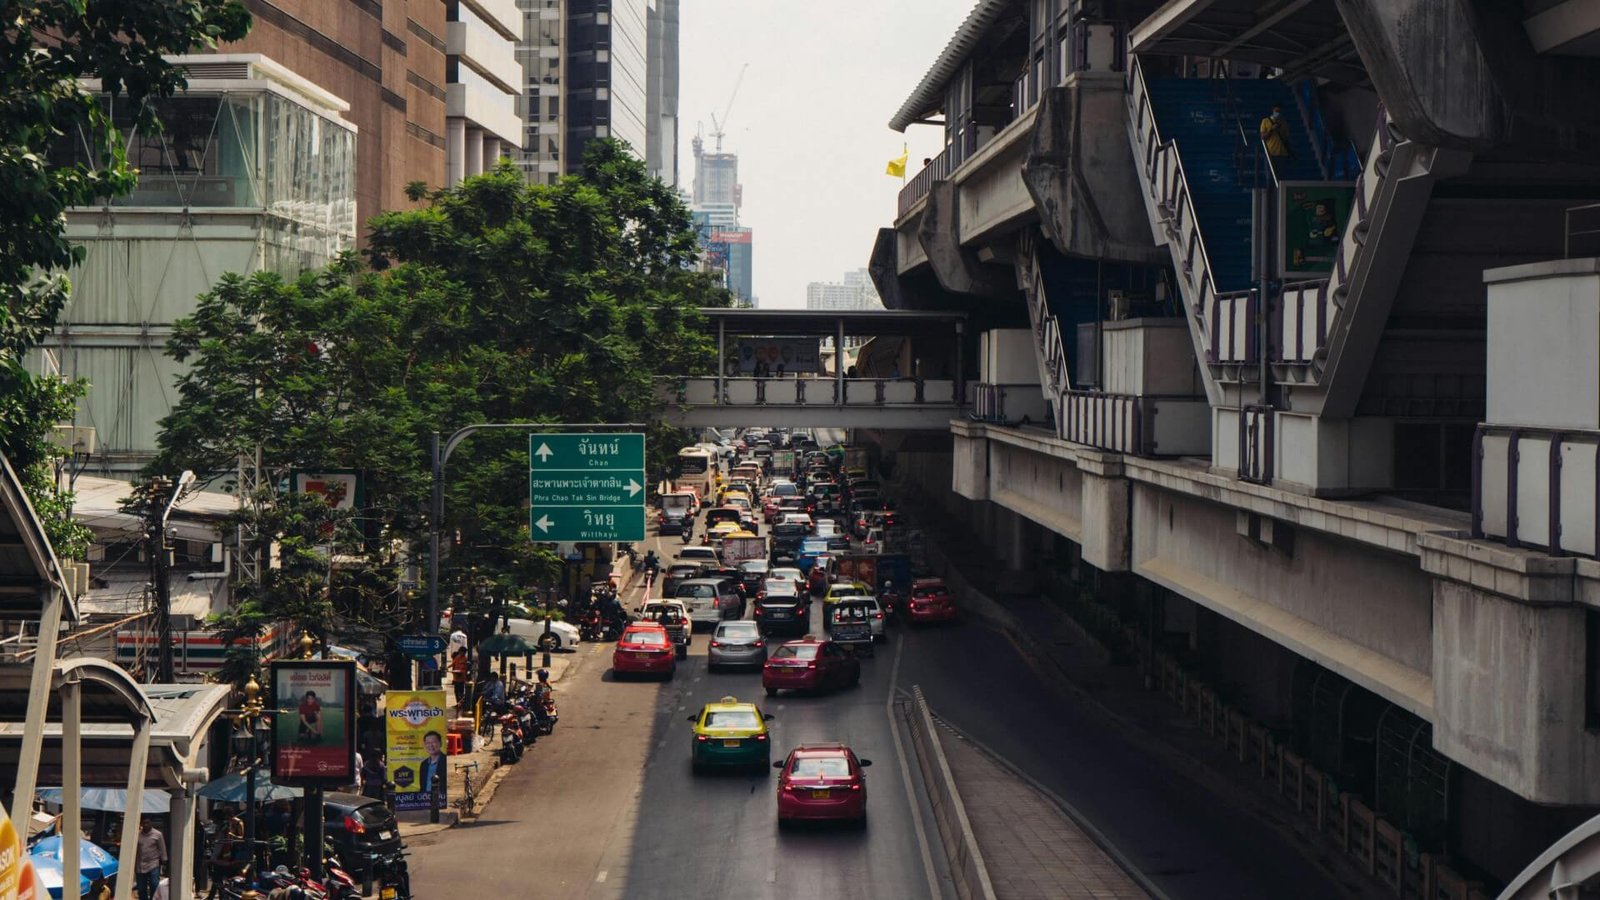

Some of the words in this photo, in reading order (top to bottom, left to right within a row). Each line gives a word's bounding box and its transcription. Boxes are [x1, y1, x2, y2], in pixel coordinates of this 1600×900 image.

[578, 438, 620, 455] จันทน์
[532, 476, 622, 488] สะพานพระเจ้าตากสิน
[599, 494, 621, 503] Bridge
[583, 509, 615, 530] วิทยุ
[580, 531, 618, 539] Witthayu
[433, 640, 440, 648] 3
